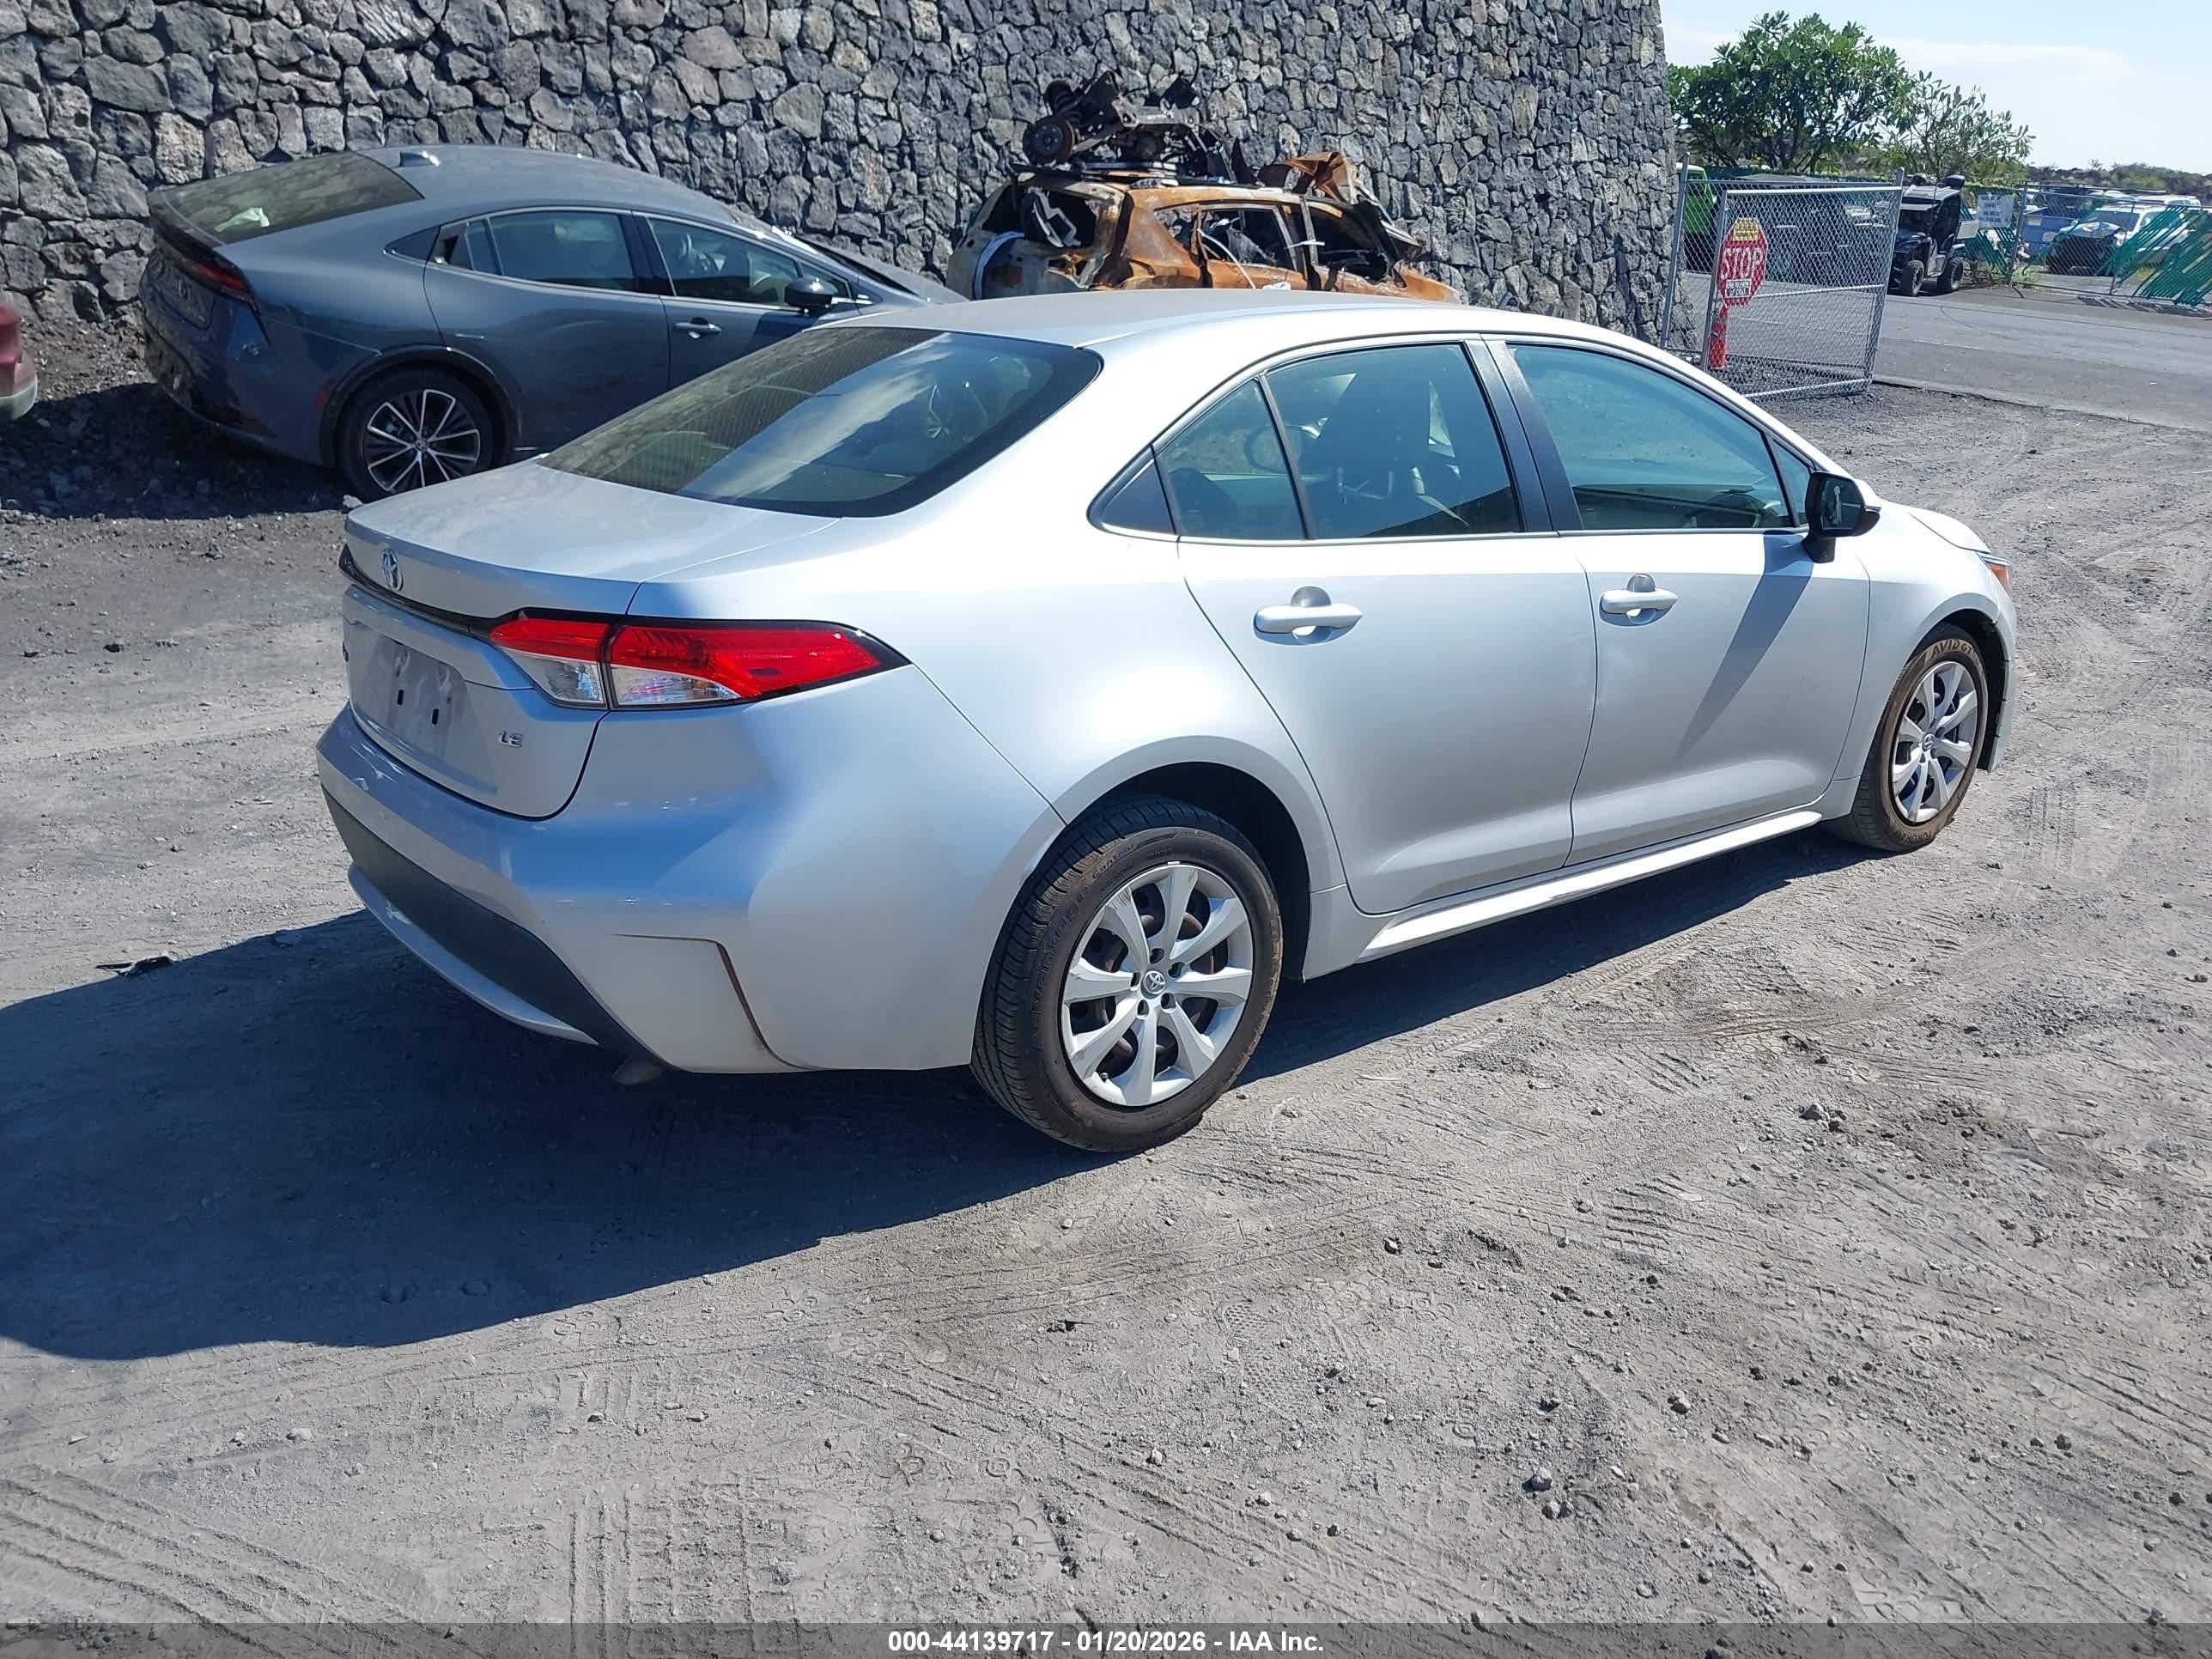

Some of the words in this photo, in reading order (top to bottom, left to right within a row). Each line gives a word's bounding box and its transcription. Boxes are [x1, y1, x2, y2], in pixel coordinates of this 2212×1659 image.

[1721, 247, 1764, 280] STOP
[1930, 639, 1960, 660] AVID
[499, 730, 523, 748] LE
